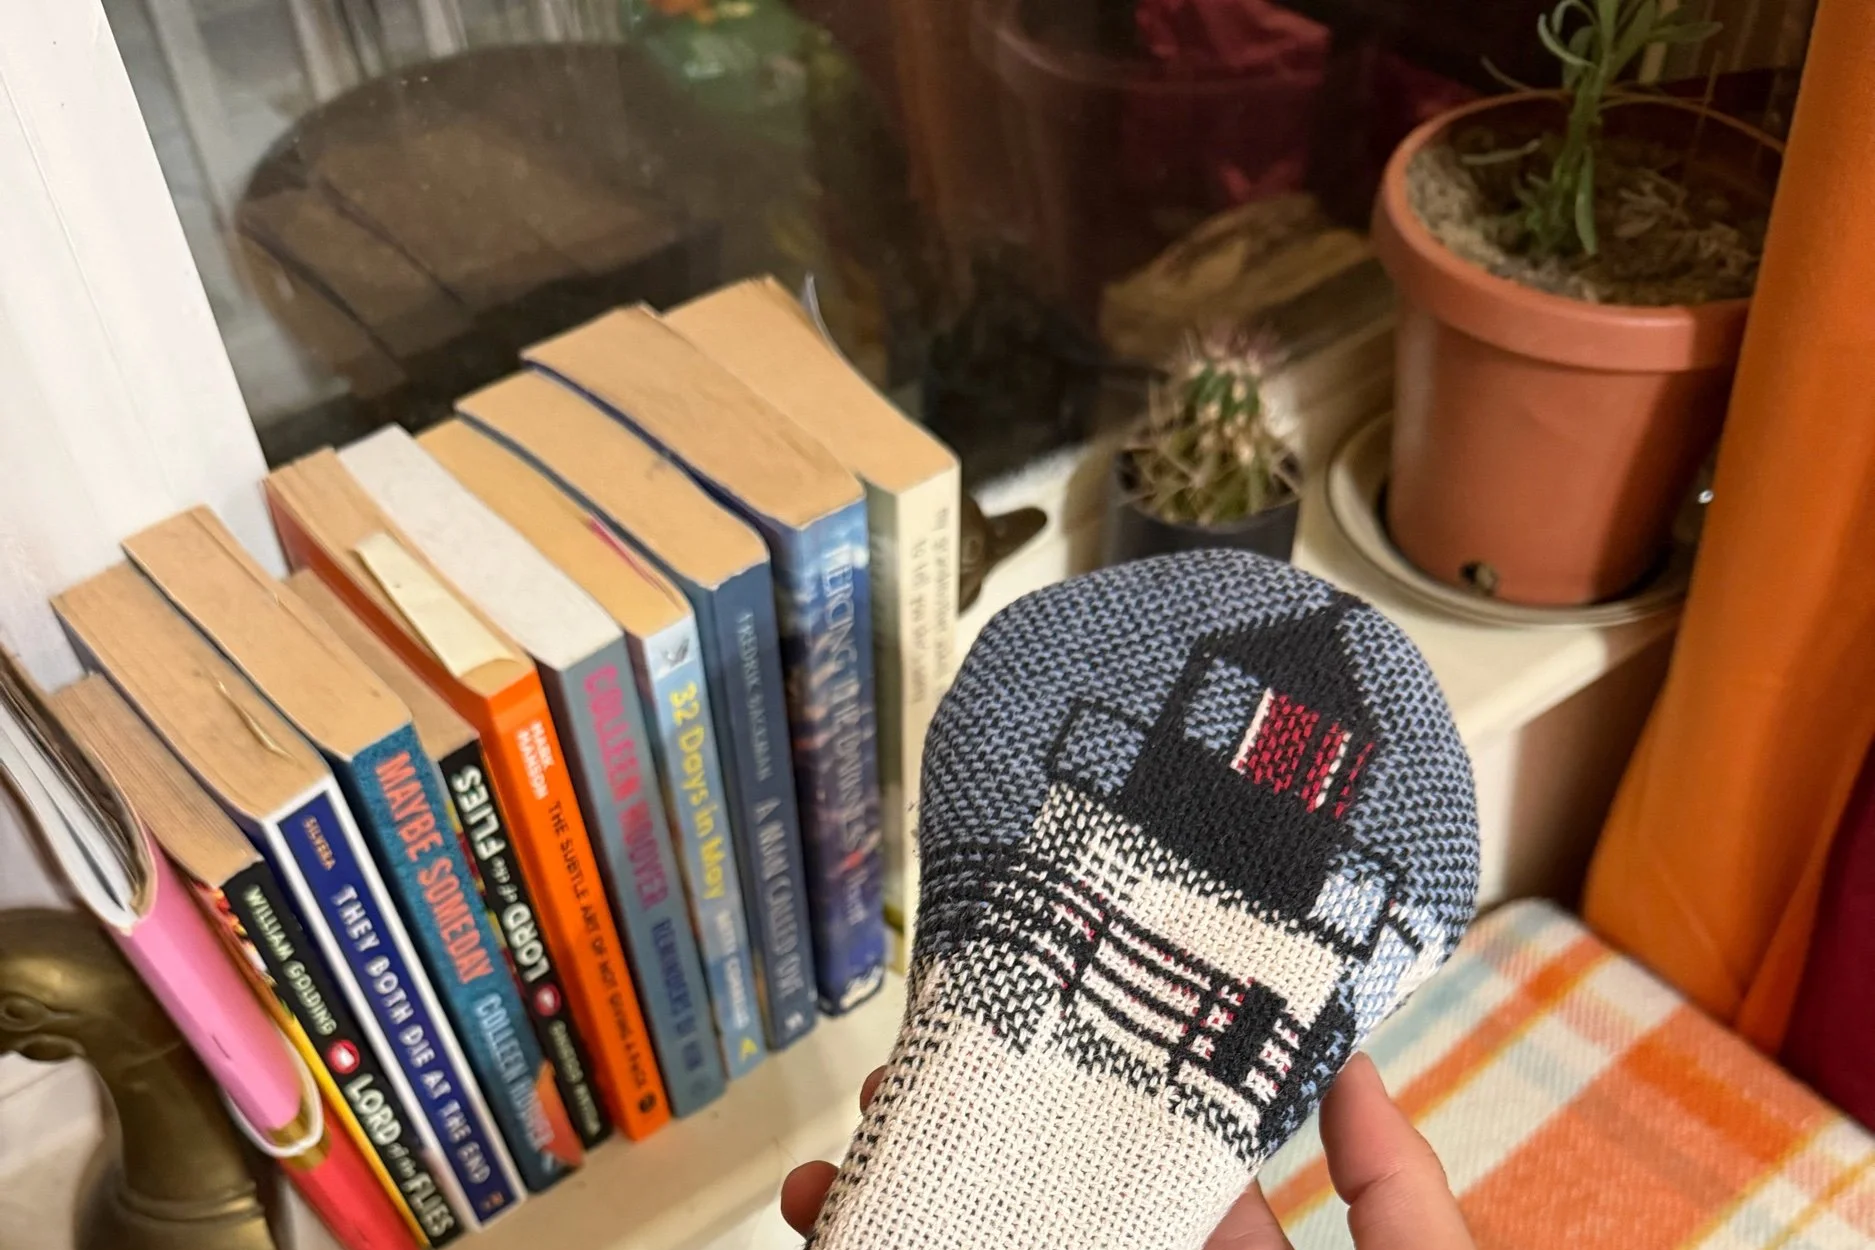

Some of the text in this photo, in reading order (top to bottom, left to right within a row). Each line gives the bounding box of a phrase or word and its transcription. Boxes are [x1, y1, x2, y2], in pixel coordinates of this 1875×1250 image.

[515, 729, 549, 799] MANSON
[530, 720, 555, 769] MARK
[451, 765, 507, 861] FLIES
[584, 664, 669, 911] COLLEEN HOOVER
[669, 682, 729, 900] 32 Days in May
[302, 815, 334, 871] SILVERA
[548, 802, 569, 835] THE
[492, 858, 511, 887] the
[560, 840, 588, 899] SUBTLE
[757, 821, 788, 879] MAN
[375, 750, 436, 862] MAYBE
[418, 856, 495, 986] SOMEDAY
[475, 992, 528, 1090] COLLEEN
[499, 883, 519, 901] of
[581, 903, 600, 936] ART
[766, 879, 798, 953] CALLED
[504, 900, 552, 983] LORD
[593, 936, 607, 958] OF
[598, 960, 617, 990] NOT
[244, 884, 293, 962] WILLIAM
[286, 962, 337, 1037] GOLDING
[345, 1073, 403, 1146] LORD
[403, 1172, 455, 1238] FLIES
[330, 885, 492, 1185] THEY BOTH DIE AT THE END
